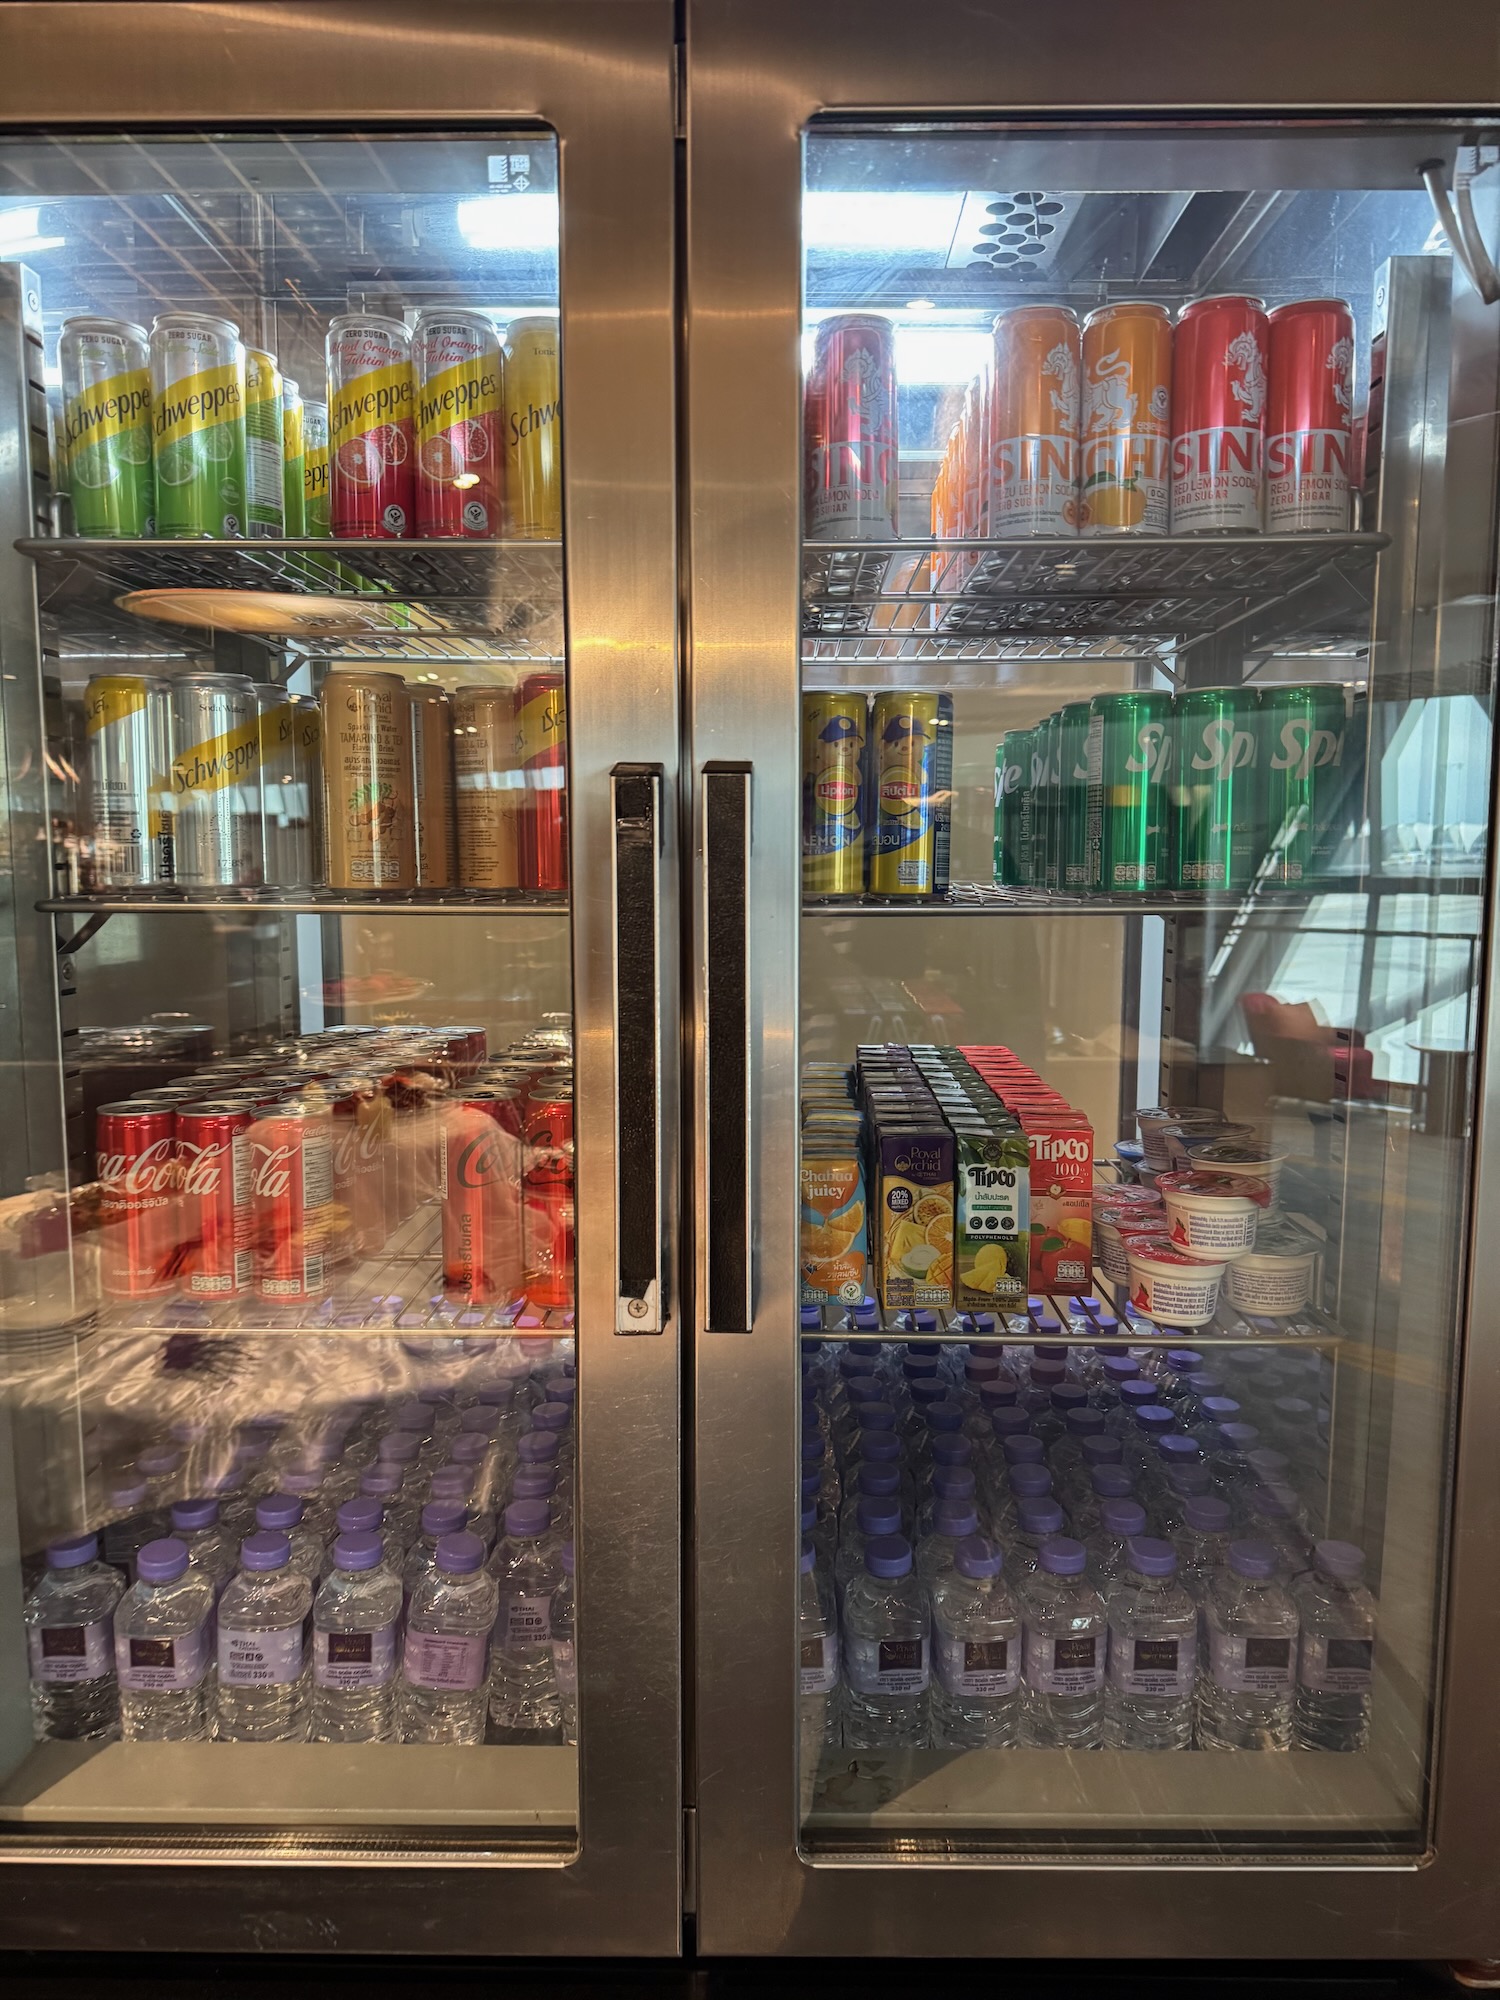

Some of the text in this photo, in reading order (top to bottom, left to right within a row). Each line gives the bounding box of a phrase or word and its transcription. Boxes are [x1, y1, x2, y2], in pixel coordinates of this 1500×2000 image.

[168, 331, 212, 342] ZERO SUGAR
[346, 330, 388, 340] ZERO SUGAR
[426, 326, 467, 336] ZERO SUGAR
[82, 335, 127, 346] ZERO SUGAR
[442, 337, 484, 352] Orange
[362, 342, 403, 359] Orange
[533, 347, 557, 356] Tonic
[330, 380, 413, 435] chweppes
[415, 374, 498, 434] chweppes
[56, 388, 150, 448] Schweppe
[1174, 483, 1189, 495] RED
[1190, 477, 1229, 492] LEMON
[1271, 483, 1290, 495] RED
[1293, 479, 1331, 492] LEMON
[1174, 489, 1228, 508] ZERO SUGAR
[1271, 492, 1331, 507] ZERO SUGAR
[820, 784, 855, 798] Lipton
[802, 835, 851, 847] LEMON
[910, 1146, 941, 1160] Royal
[801, 1169, 853, 1182] Chabaa
[1055, 1162, 1089, 1176] 100%
[807, 1184, 846, 1200] juicy
[891, 1189, 909, 1199] 20%
